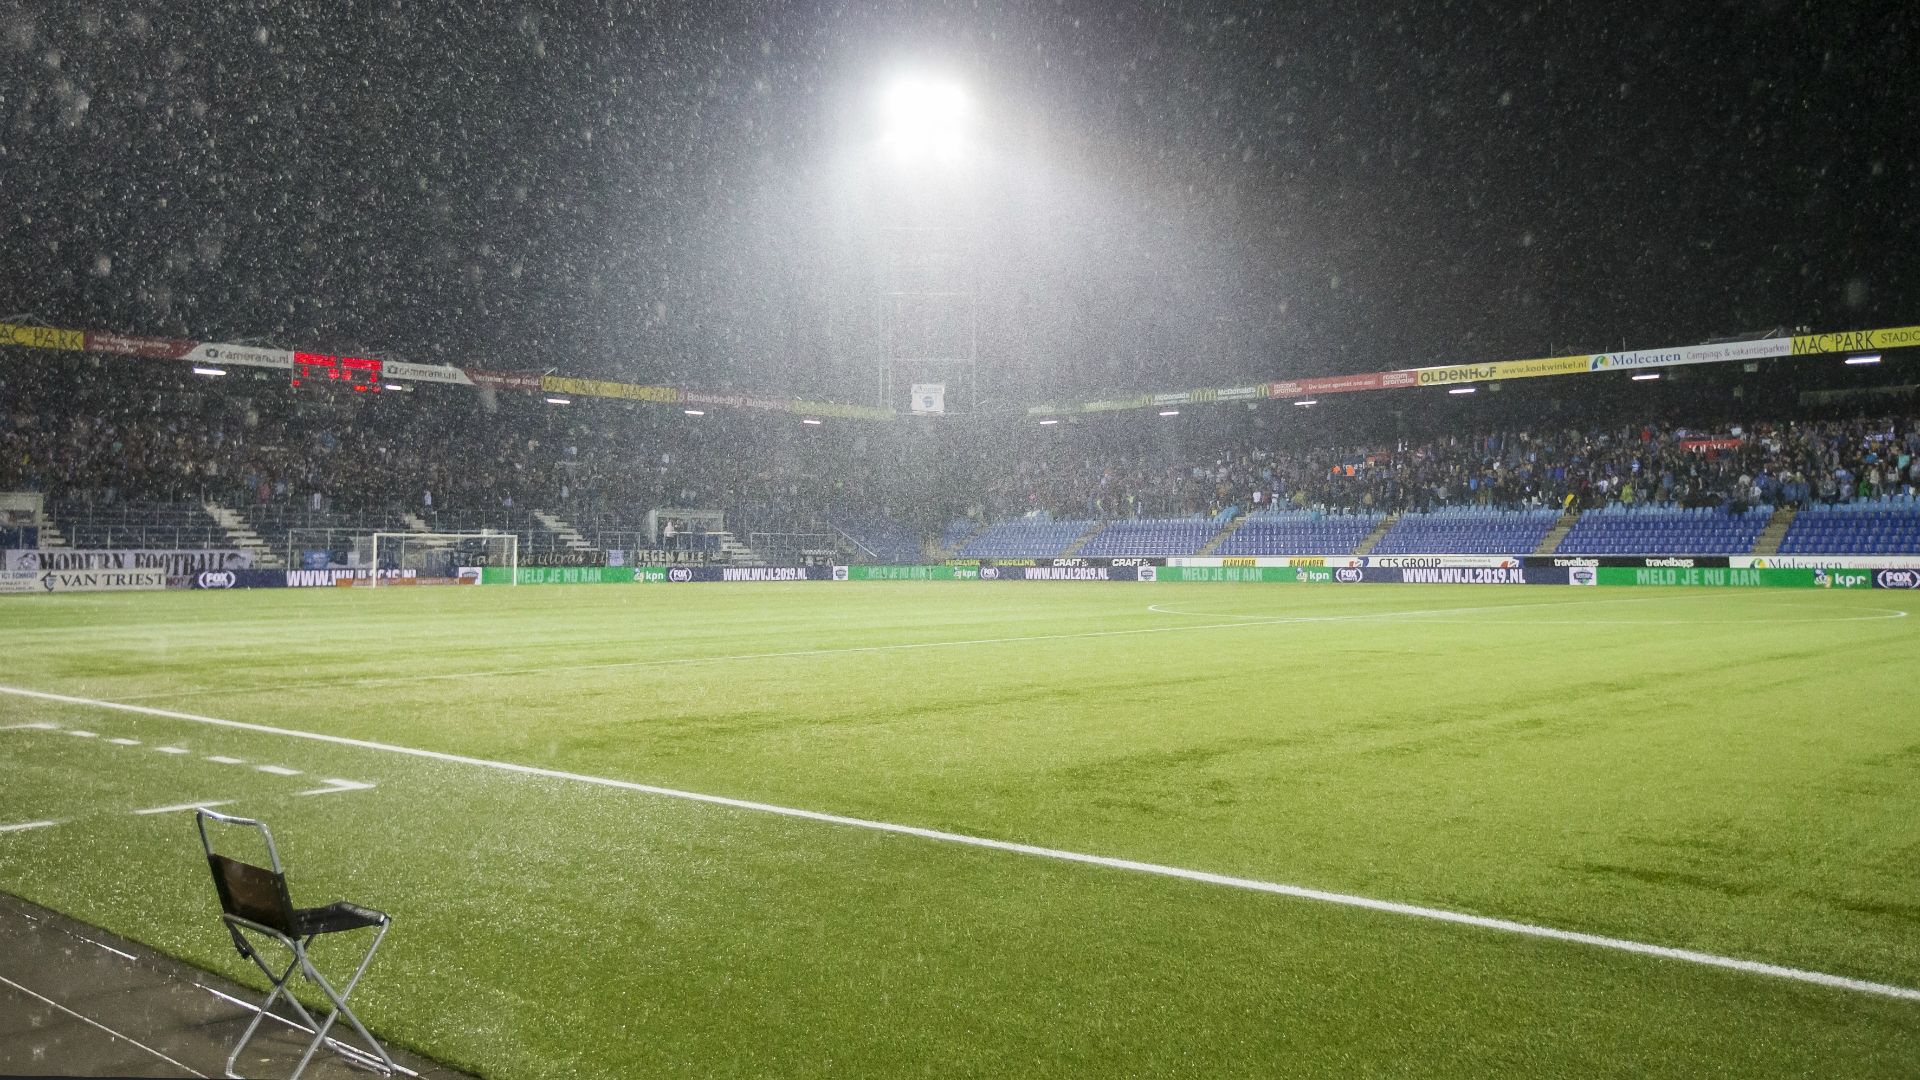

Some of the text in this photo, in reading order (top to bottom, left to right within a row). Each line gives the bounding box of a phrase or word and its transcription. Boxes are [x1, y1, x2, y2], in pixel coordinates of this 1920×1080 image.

[1612, 353, 1681, 366] Molecaten
[638, 550, 674, 562] TEGEN
[1053, 559, 1081, 567] CRAFT
[1112, 559, 1142, 567] CRAFT
[1379, 558, 1399, 567] CTS
[1401, 558, 1442, 567] GROUP
[1554, 557, 1599, 567] travelbags
[1646, 557, 1694, 568] travelbags
[60, 572, 163, 586] VAN TRIEST
[646, 571, 664, 582] kpn
[963, 568, 977, 580] kpn
[1182, 568, 1262, 581] MELD JE NU AAN
[1309, 572, 1330, 583] kpn
[1340, 569, 1357, 578] FOX
[1403, 569, 1525, 583] WWW.WVJL2019.NL
[1637, 570, 1761, 586] MELD JE NU AAN
[1885, 571, 1913, 582] FOX
